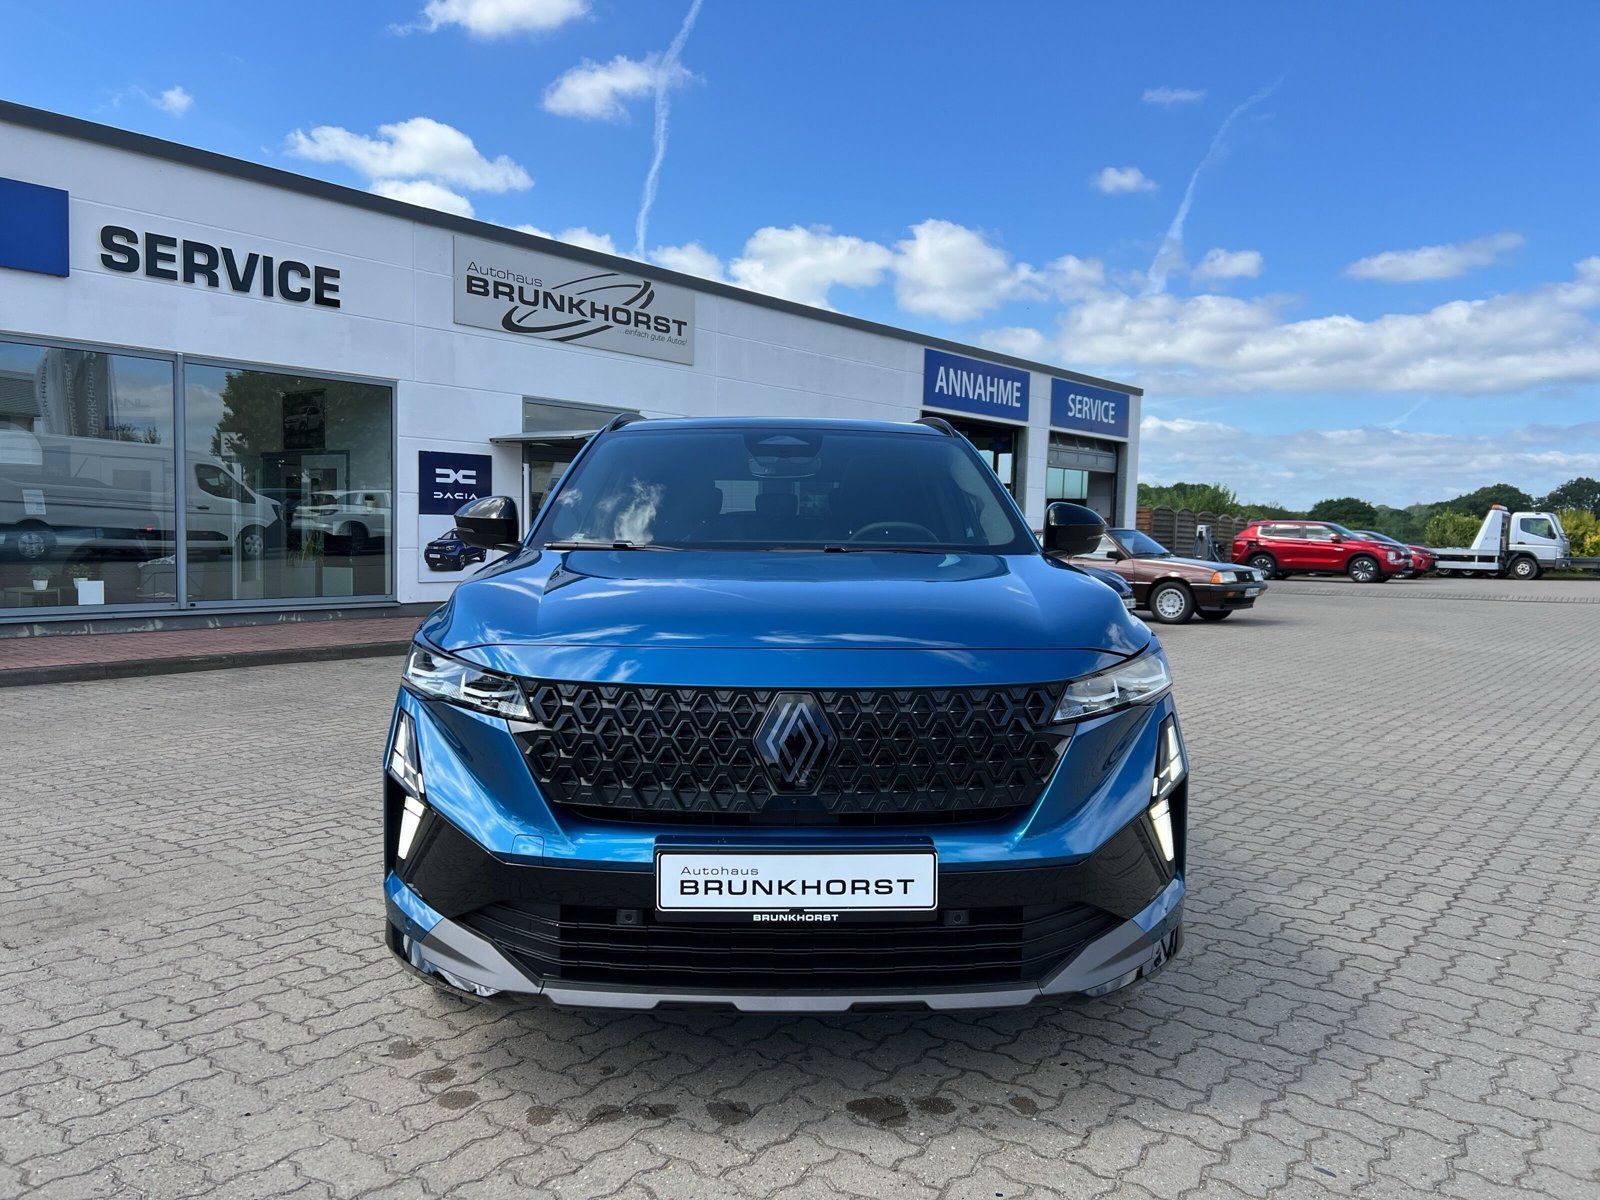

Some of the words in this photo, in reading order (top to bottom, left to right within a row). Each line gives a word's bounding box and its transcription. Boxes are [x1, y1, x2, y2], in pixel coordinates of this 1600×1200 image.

[99, 224, 341, 308] SERVICE
[466, 261, 543, 287] Autohaus
[466, 274, 687, 336] BRUNKHORST
[651, 333, 666, 343] gute
[667, 335, 688, 346] Autos!
[934, 366, 1022, 408] ANNAHME
[1067, 393, 1116, 424] SERVICE
[434, 491, 477, 500] DACIA
[680, 866, 759, 876] Autohaus
[680, 879, 915, 896] BRUNKHORST
[752, 914, 839, 923] BRUNKHORST
